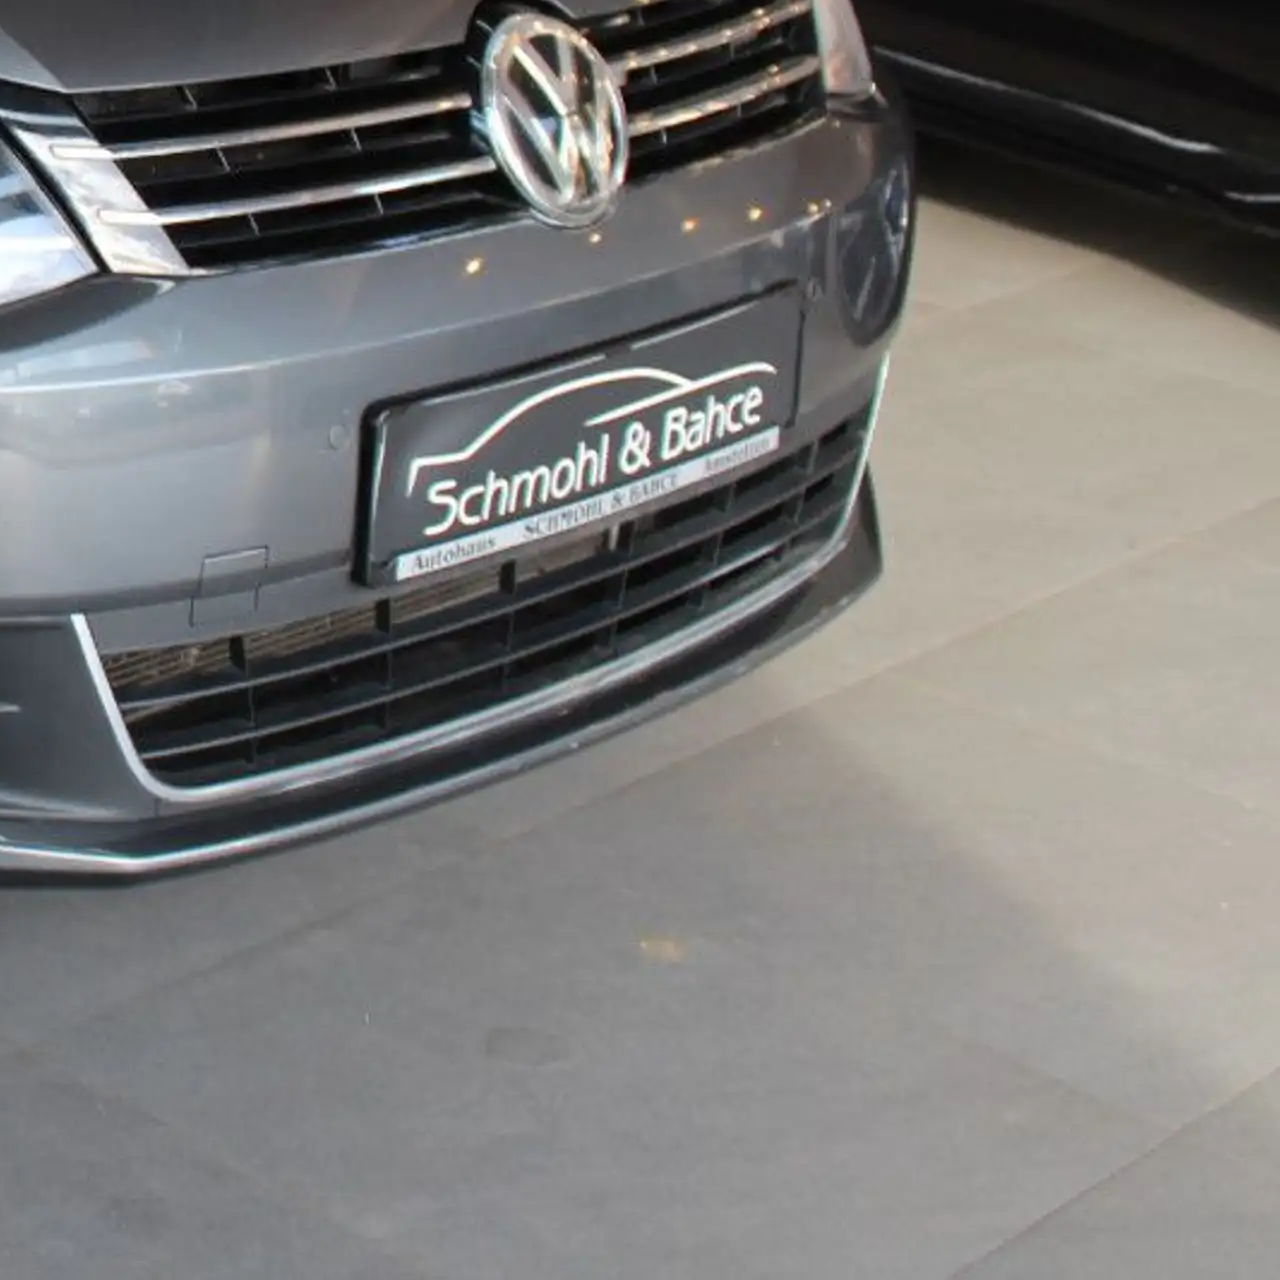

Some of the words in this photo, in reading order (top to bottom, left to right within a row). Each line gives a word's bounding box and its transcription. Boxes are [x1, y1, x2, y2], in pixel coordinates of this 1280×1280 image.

[422, 433, 610, 536] Schmohl
[619, 421, 651, 474] &
[660, 386, 763, 460] Bahce
[412, 538, 496, 570] Autohaus
